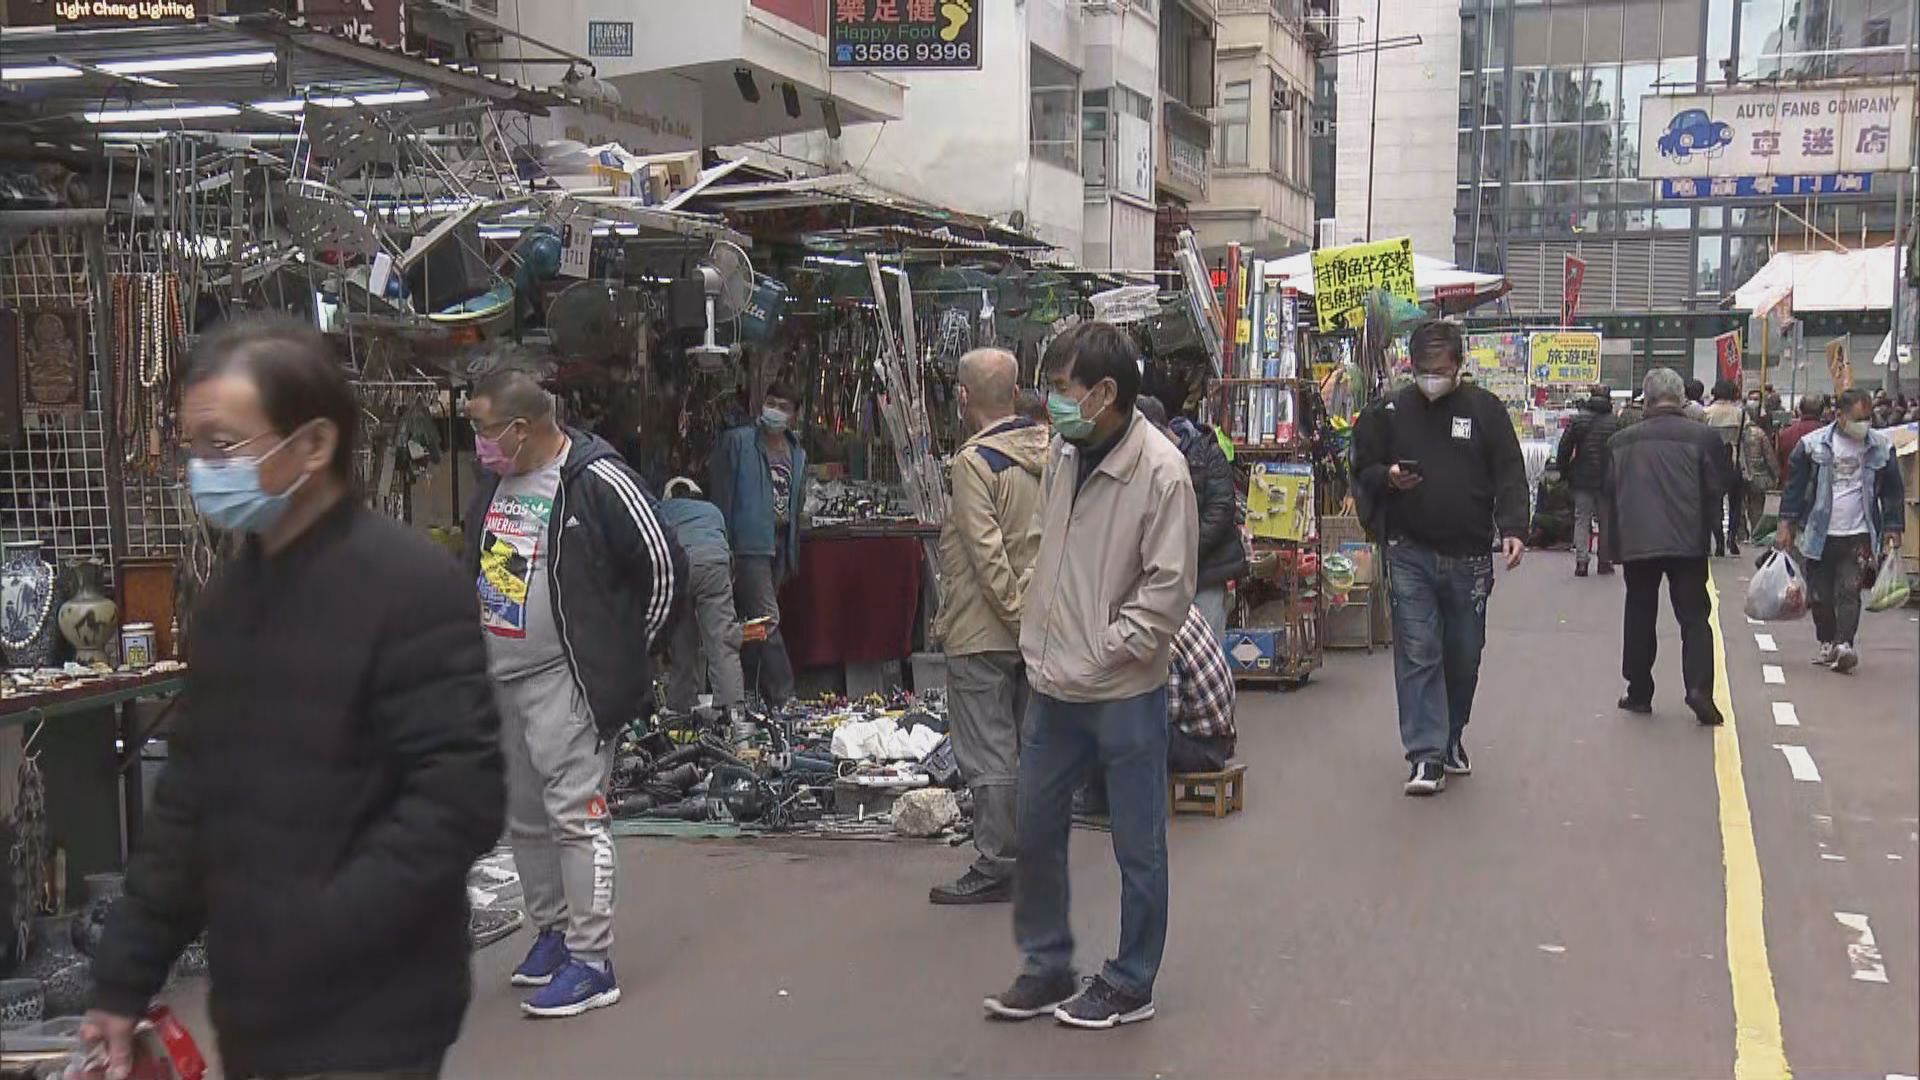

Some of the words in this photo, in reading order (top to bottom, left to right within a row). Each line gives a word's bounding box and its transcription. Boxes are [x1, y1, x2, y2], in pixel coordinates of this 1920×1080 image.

[55, 2, 91, 20] Light
[139, 1, 195, 20] Lighting
[835, 25, 891, 42] Happy
[898, 24, 937, 40] Foot
[855, 43, 910, 62] 3586
[915, 42, 972, 61] 9396
[1736, 103, 1776, 119] AUTO
[1781, 101, 1821, 117] FANS
[1828, 95, 1900, 115] COMPANY
[1750, 123, 1890, 157] 車迷店
[1547, 349, 1597, 365] 旅遊咭
[490, 499, 529, 516] adidas
